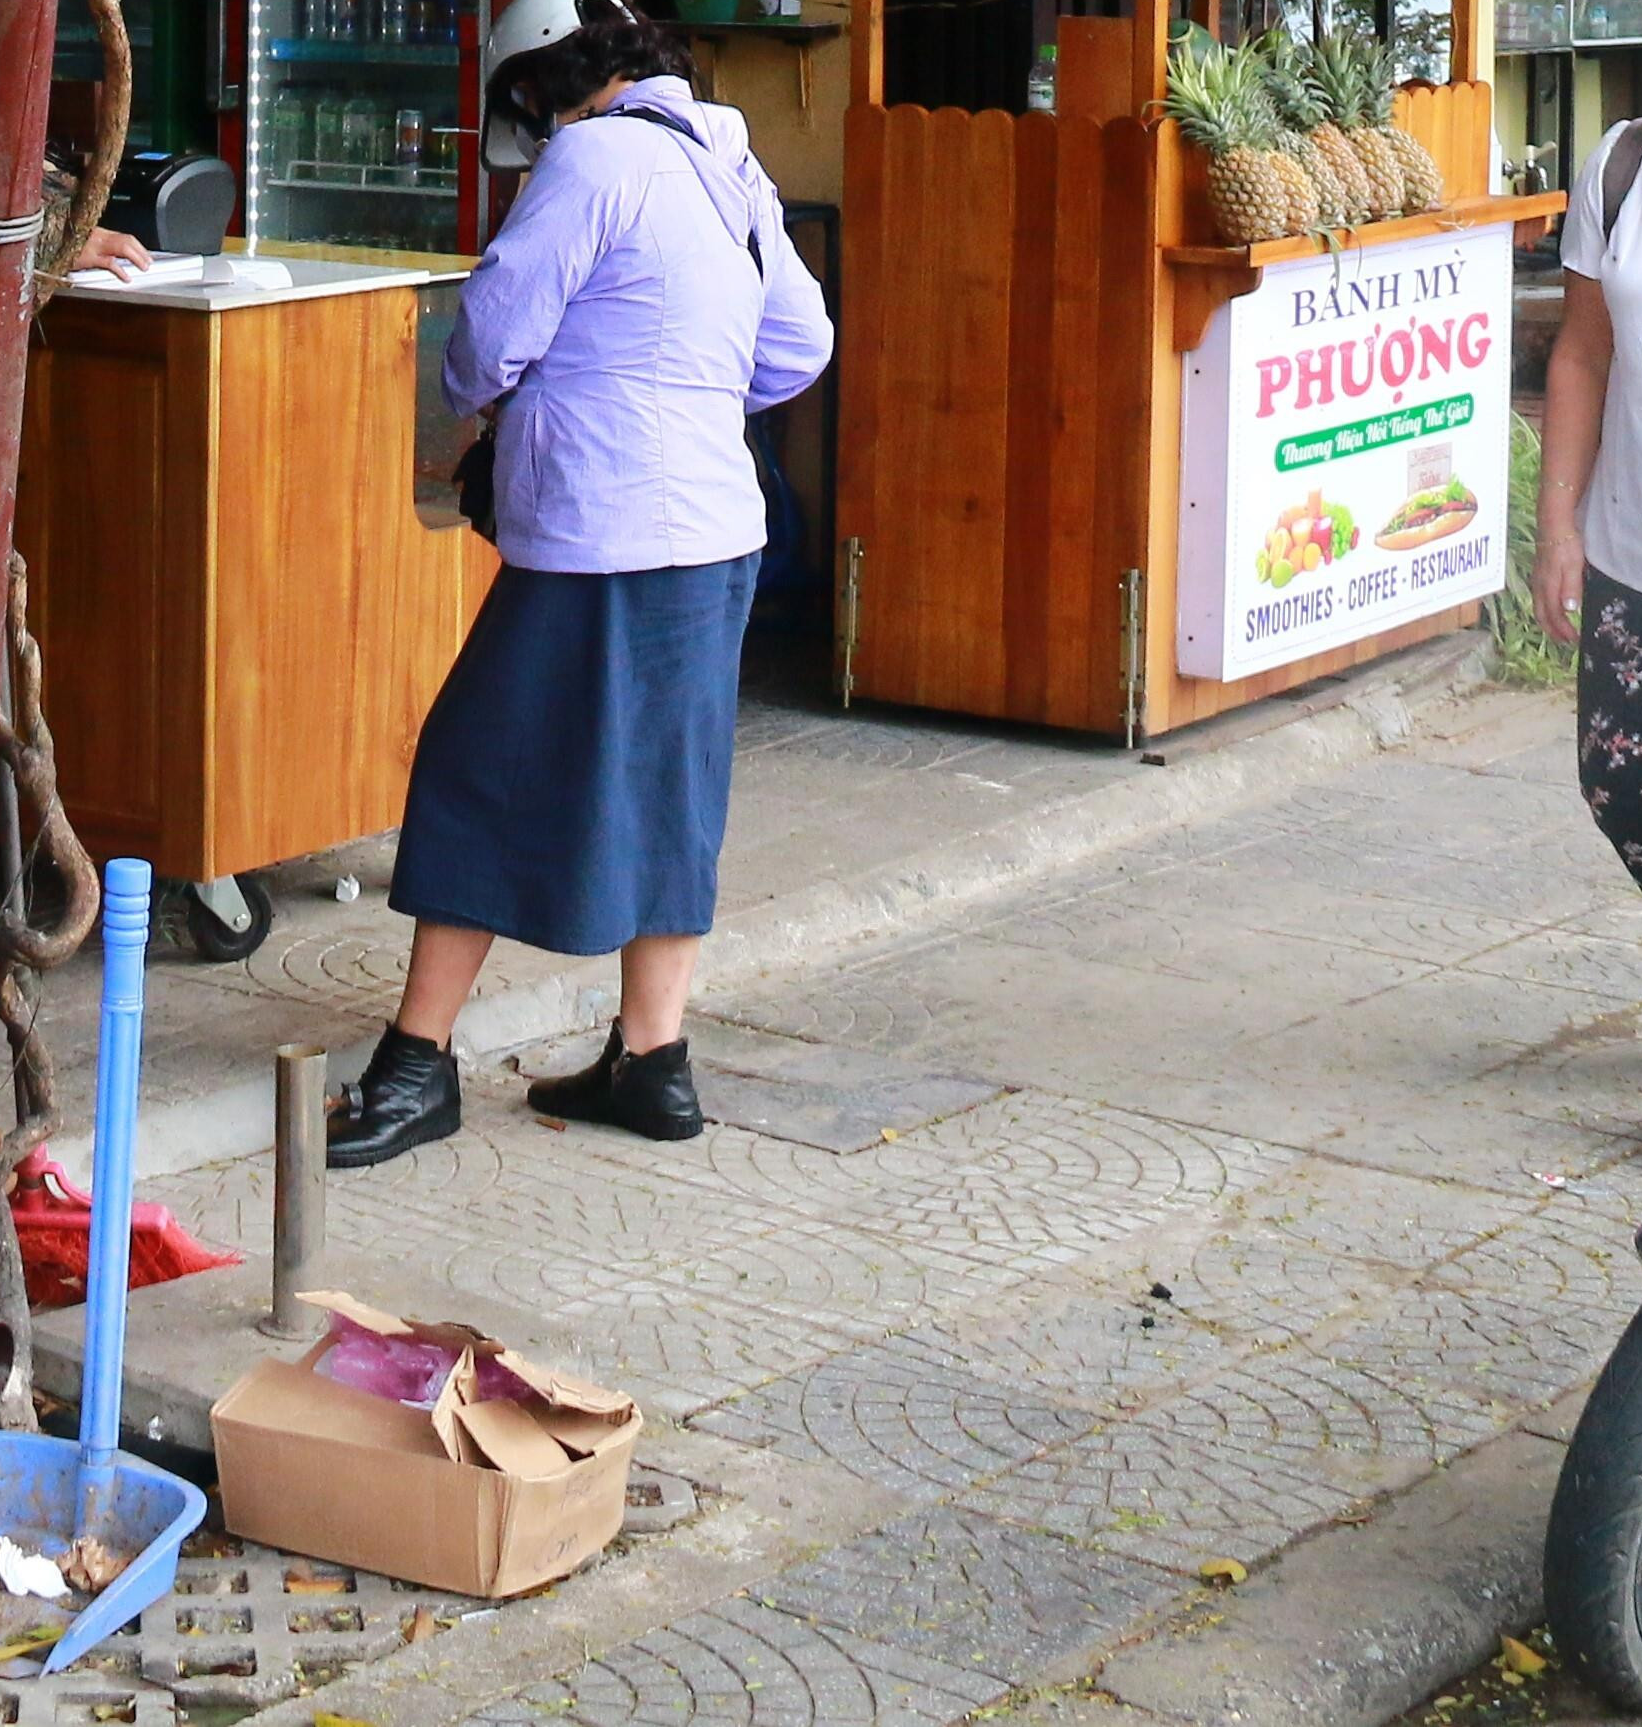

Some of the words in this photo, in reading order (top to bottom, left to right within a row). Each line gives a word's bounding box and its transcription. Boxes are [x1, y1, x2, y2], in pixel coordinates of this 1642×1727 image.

[1413, 248, 1467, 304] MỲ
[1255, 312, 1492, 419] PHƯỢNG
[1246, 585, 1334, 643] SMOOTHIES
[1348, 565, 1399, 611] COFFEE
[1411, 535, 1491, 590] RESTAURANT
